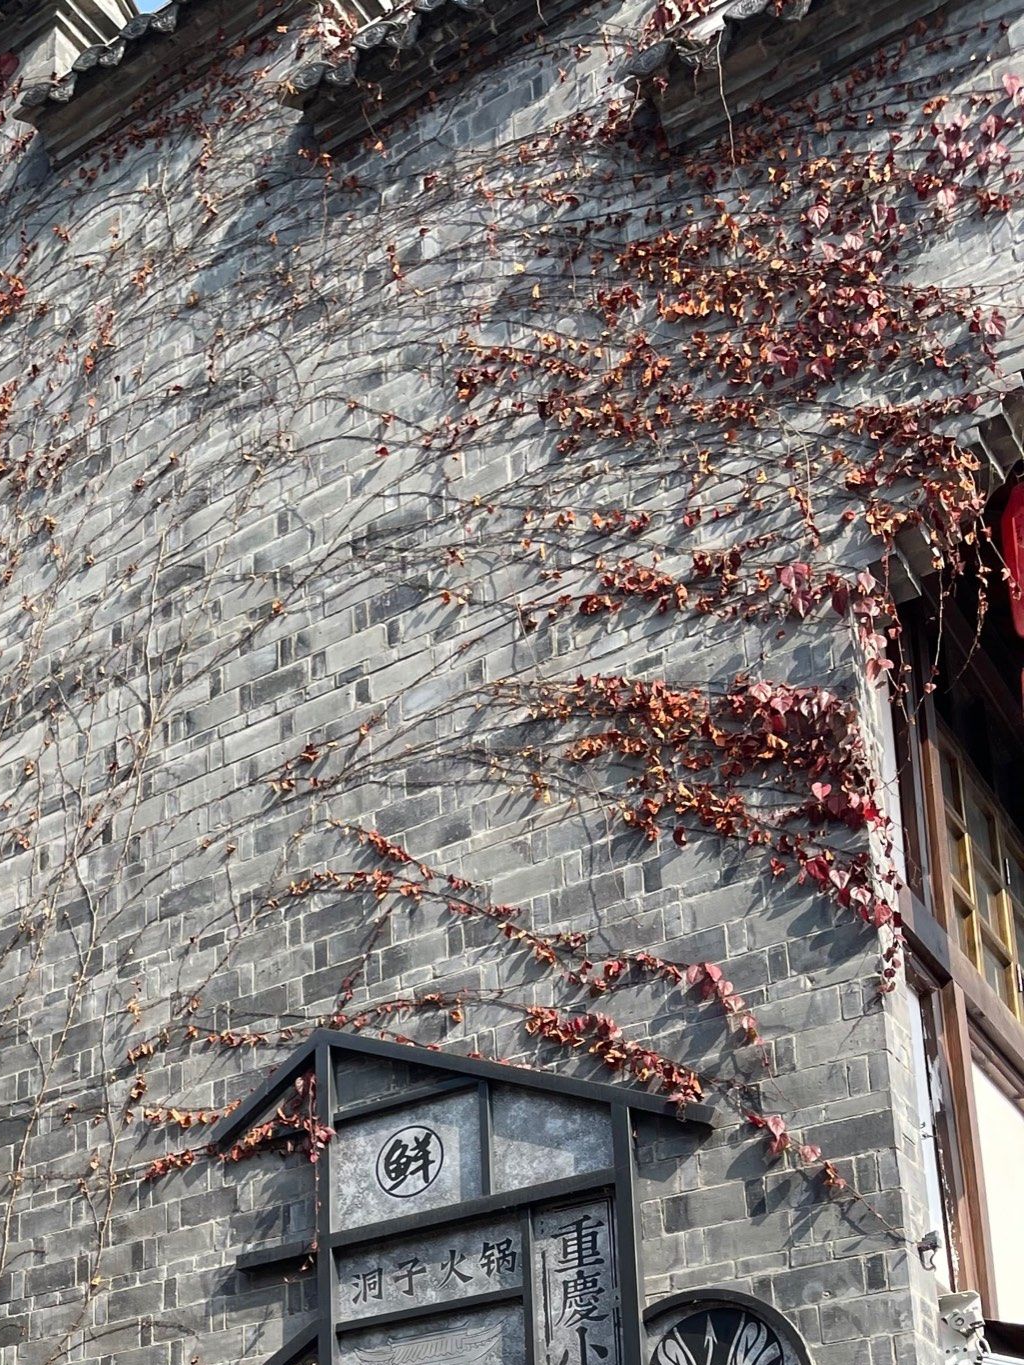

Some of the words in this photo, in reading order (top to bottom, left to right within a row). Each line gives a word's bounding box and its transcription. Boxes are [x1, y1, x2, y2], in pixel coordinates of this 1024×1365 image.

[384, 1131, 436, 1191] 鲜
[352, 1237, 517, 1304] 洞子火锅
